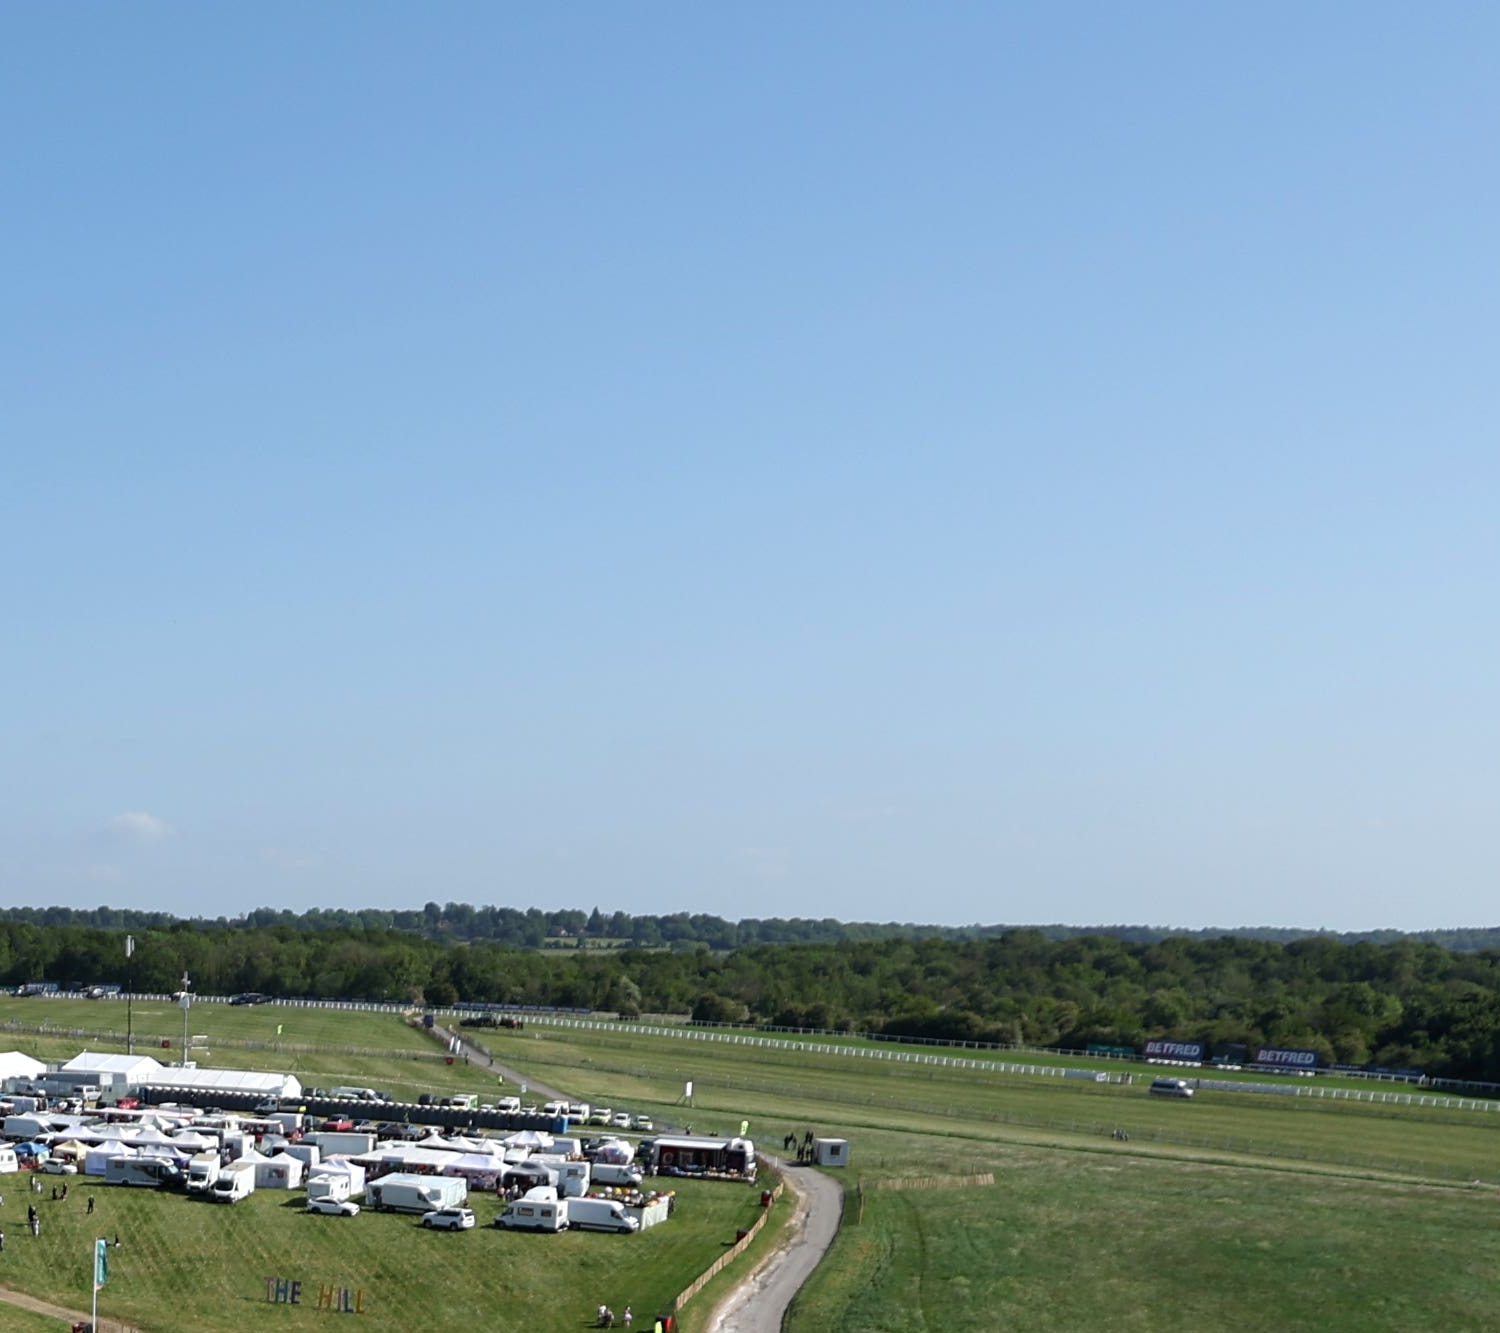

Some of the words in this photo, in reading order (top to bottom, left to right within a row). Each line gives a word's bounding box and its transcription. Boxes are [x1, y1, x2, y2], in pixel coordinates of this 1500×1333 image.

[1146, 1042, 1200, 1056] BETFRED
[1257, 1049, 1315, 1065] BETFRED
[264, 1276, 302, 1304] THE
[319, 1283, 365, 1313] HILL
